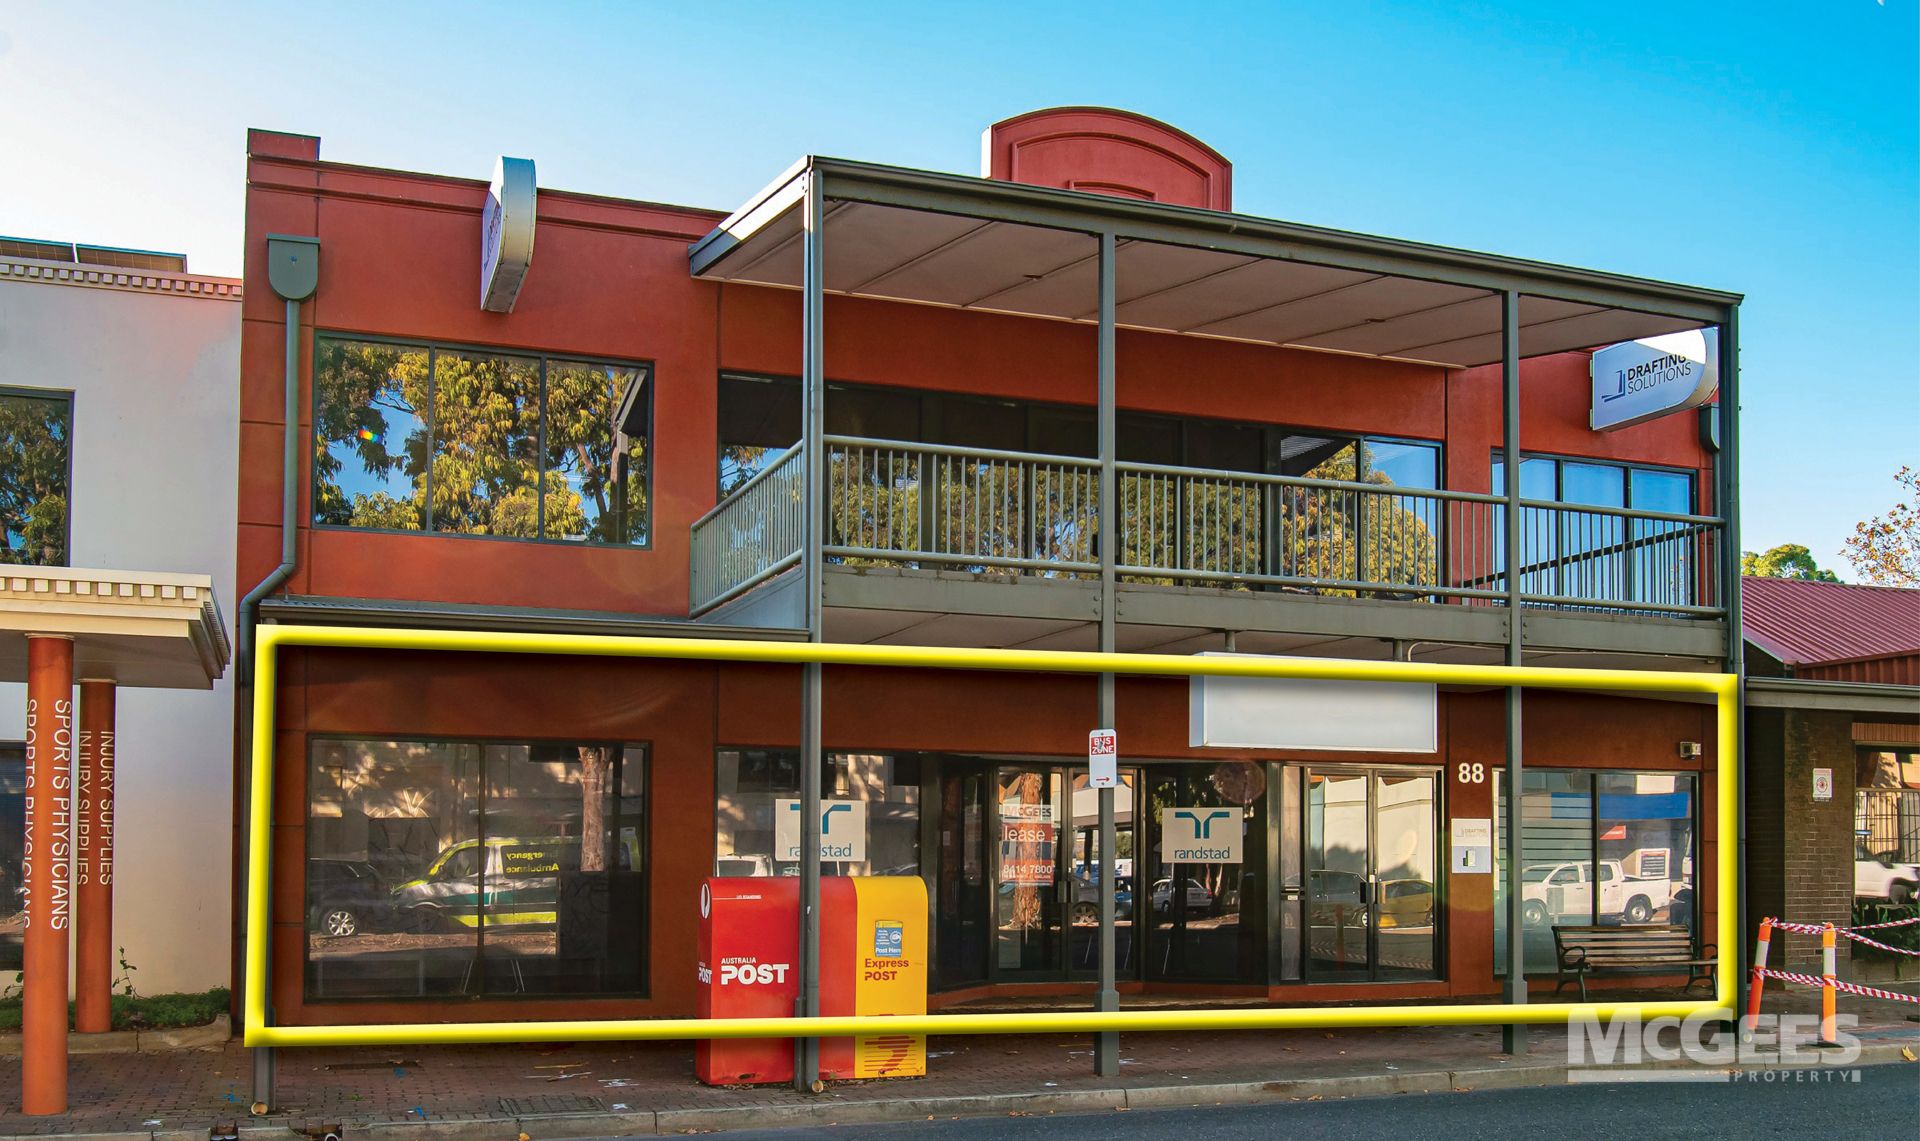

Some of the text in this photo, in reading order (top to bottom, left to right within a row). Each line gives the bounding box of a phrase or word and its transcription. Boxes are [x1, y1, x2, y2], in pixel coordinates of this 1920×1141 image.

[1627, 361, 1692, 394] SOLUTIONS
[1094, 737, 1112, 745] BUS
[1091, 746, 1114, 754] ZONE
[1458, 762, 1485, 784] 88
[51, 699, 72, 930] SPORTS PHYSICIANS
[100, 731, 115, 885] INJURY SUPPLIES
[1005, 825, 1046, 842] lease
[789, 843, 852, 857] rastad
[1174, 846, 1230, 860] randstad
[1029, 864, 1052, 874] 7800
[721, 957, 756, 965] AUSTRALIA
[865, 958, 910, 969] Express
[699, 967, 712, 985] POST
[721, 964, 789, 985] POST
[864, 971, 897, 981] POST
